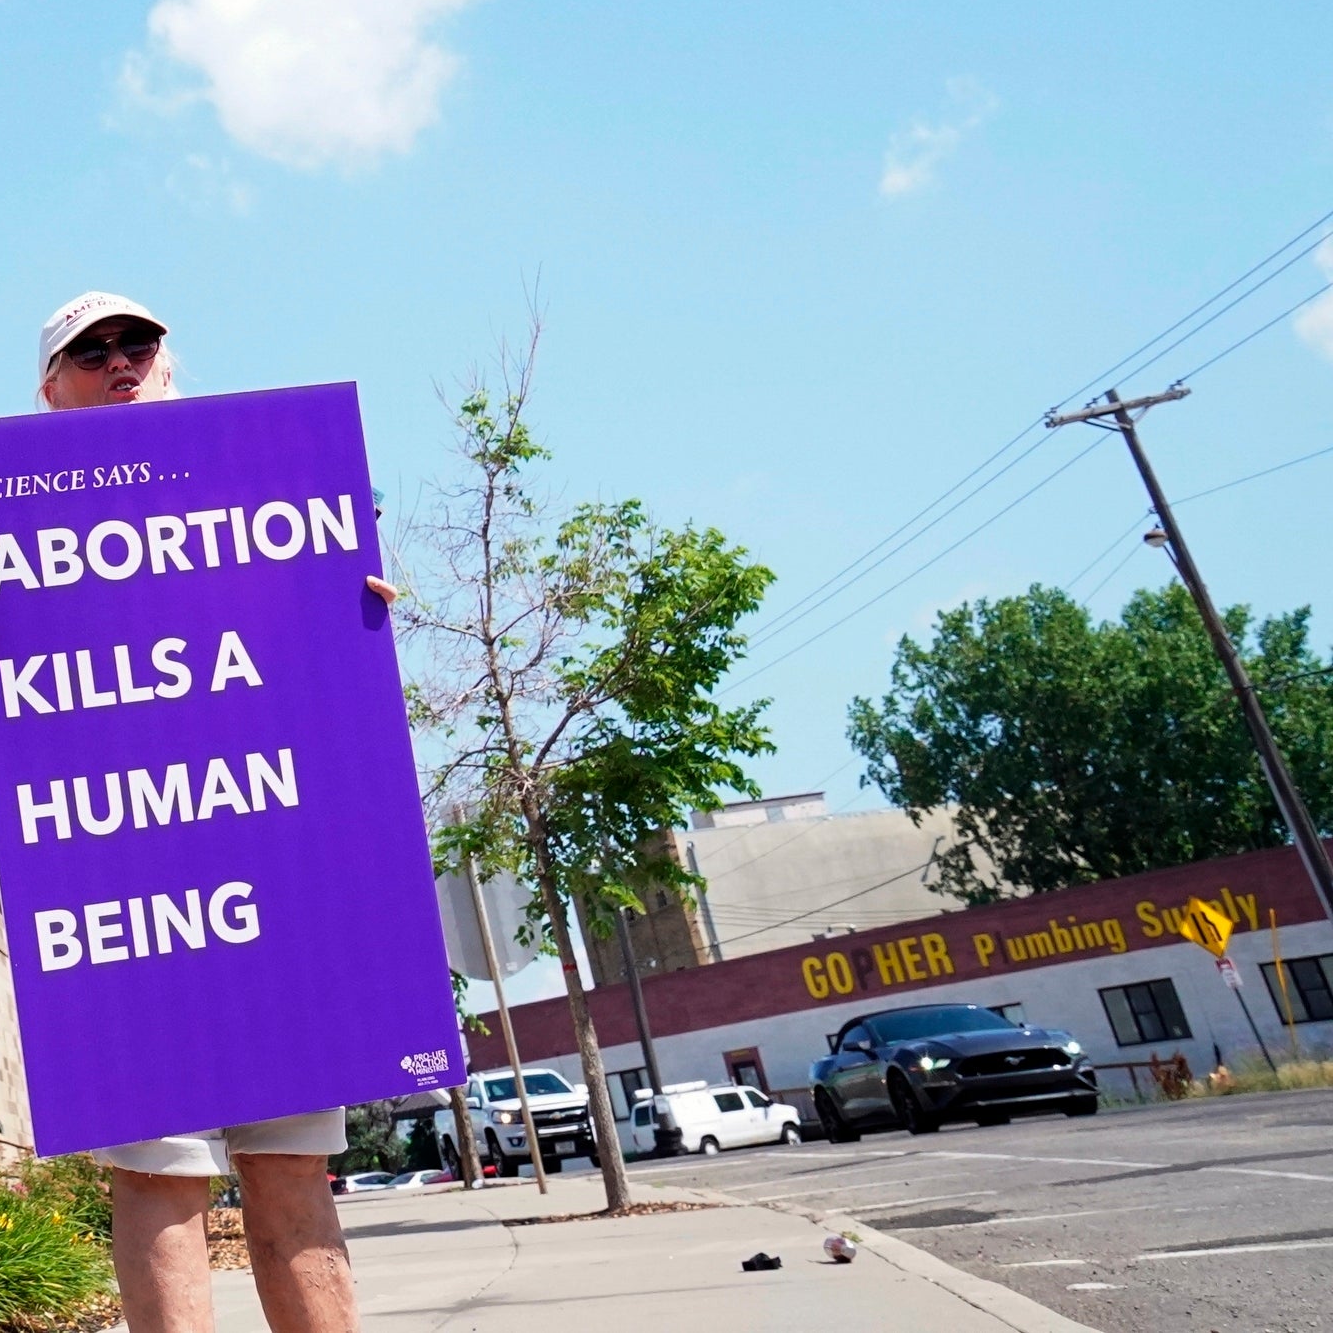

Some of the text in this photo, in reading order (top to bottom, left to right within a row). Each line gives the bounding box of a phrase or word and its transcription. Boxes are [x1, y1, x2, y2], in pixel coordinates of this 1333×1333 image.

[93, 462, 151, 487] SAYS
[0, 631, 264, 718] KILLS A
[16, 748, 300, 844] HUMAN
[34, 881, 261, 972] BEING
[1136, 887, 1258, 938] Suly
[413, 1049, 446, 1062] PRO-LIFE
[415, 1055, 449, 1069] ACTION
